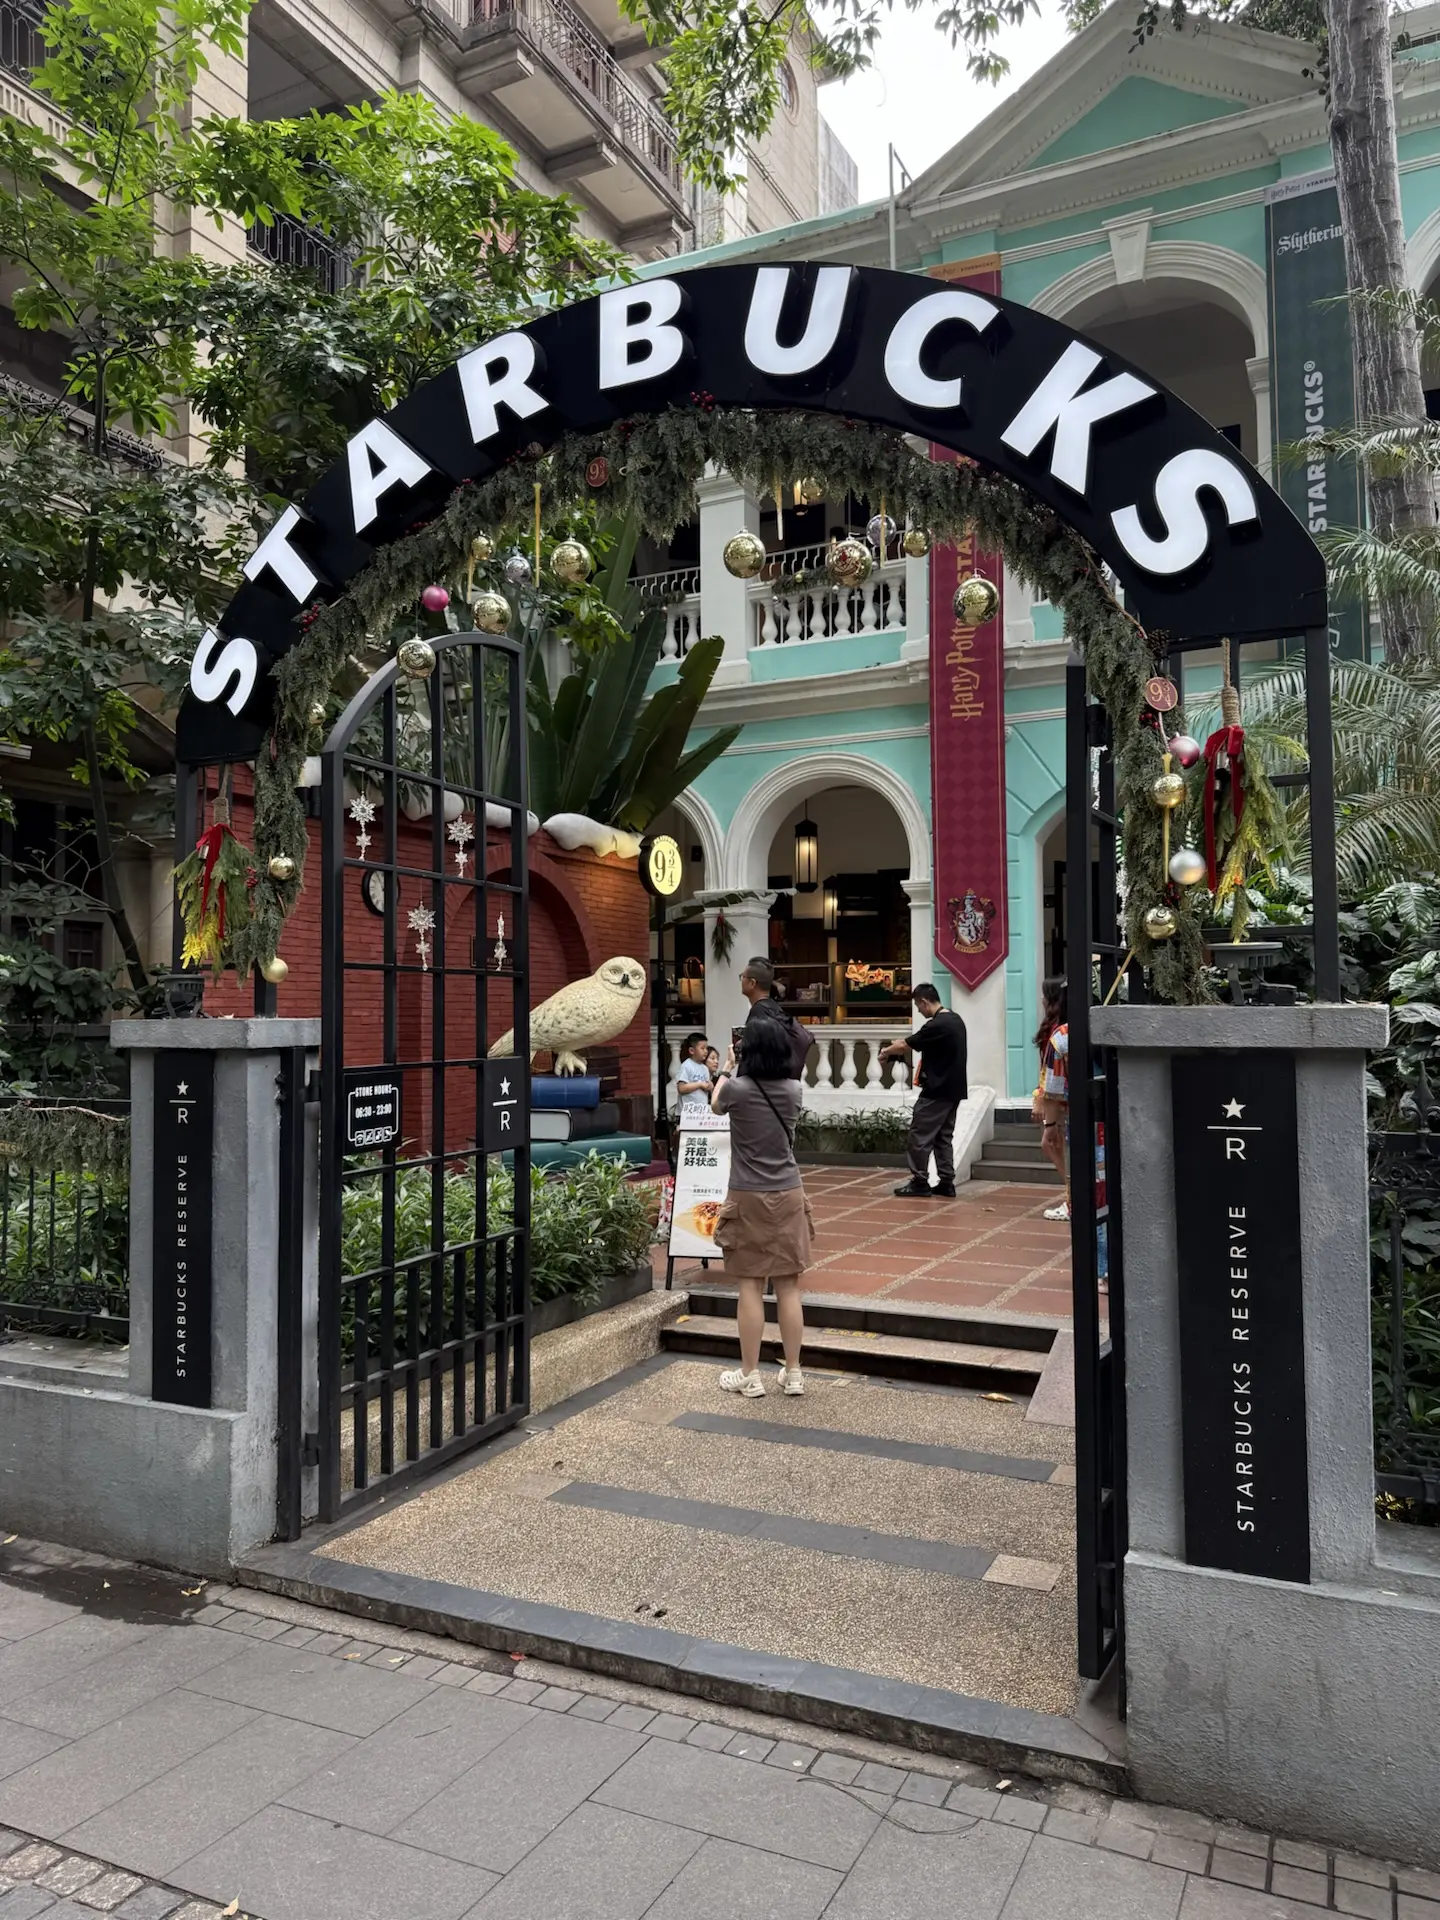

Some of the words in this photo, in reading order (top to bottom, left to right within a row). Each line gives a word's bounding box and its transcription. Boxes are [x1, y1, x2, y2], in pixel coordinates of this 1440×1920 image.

[1276, 224, 1343, 256] Slytherin
[190, 266, 1258, 715] STARBUCKS
[945, 617, 985, 666] Pott
[950, 666, 984, 722] Harry
[355, 1085, 373, 1098] STORE
[374, 1084, 392, 1096] HOURS
[177, 1108, 189, 1124] R
[355, 1106, 372, 1118] 06:30
[376, 1103, 392, 1116] 23:00
[500, 1111, 511, 1132] R
[685, 1137, 708, 1147] 美味
[685, 1147, 707, 1157] 开启
[1225, 1138, 1247, 1160] R
[684, 1157, 718, 1167] 好状态
[177, 1154, 188, 1248] RESERVE
[1228, 1206, 1250, 1341] RESERVE
[176, 1261, 187, 1377] STARBUCKS
[1232, 1362, 1255, 1532] STARBUCKS
